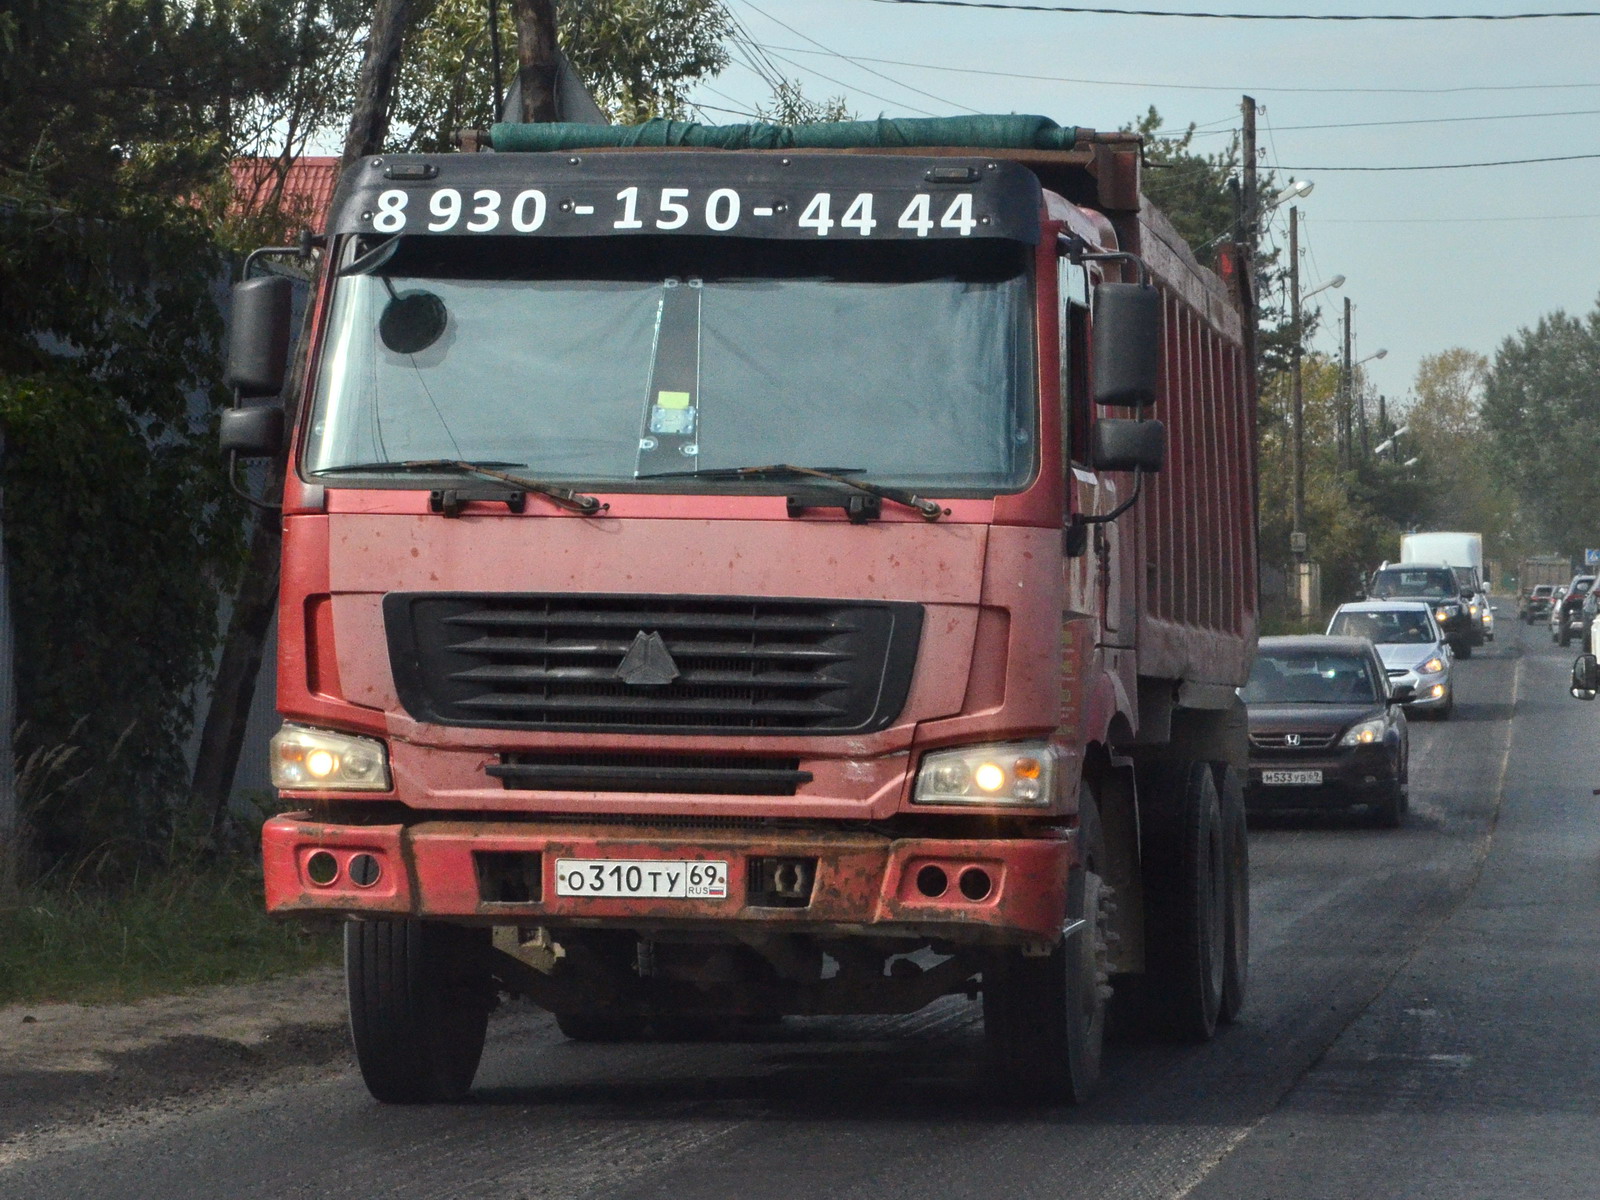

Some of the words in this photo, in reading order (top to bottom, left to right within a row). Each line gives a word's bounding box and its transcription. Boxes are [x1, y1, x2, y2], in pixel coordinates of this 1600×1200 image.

[372, 189, 409, 233] 8
[427, 188, 547, 233] 930
[798, 192, 877, 237] 44
[897, 193, 977, 237] 44
[689, 864, 718, 886] 69
[688, 887, 709, 895] RUS
